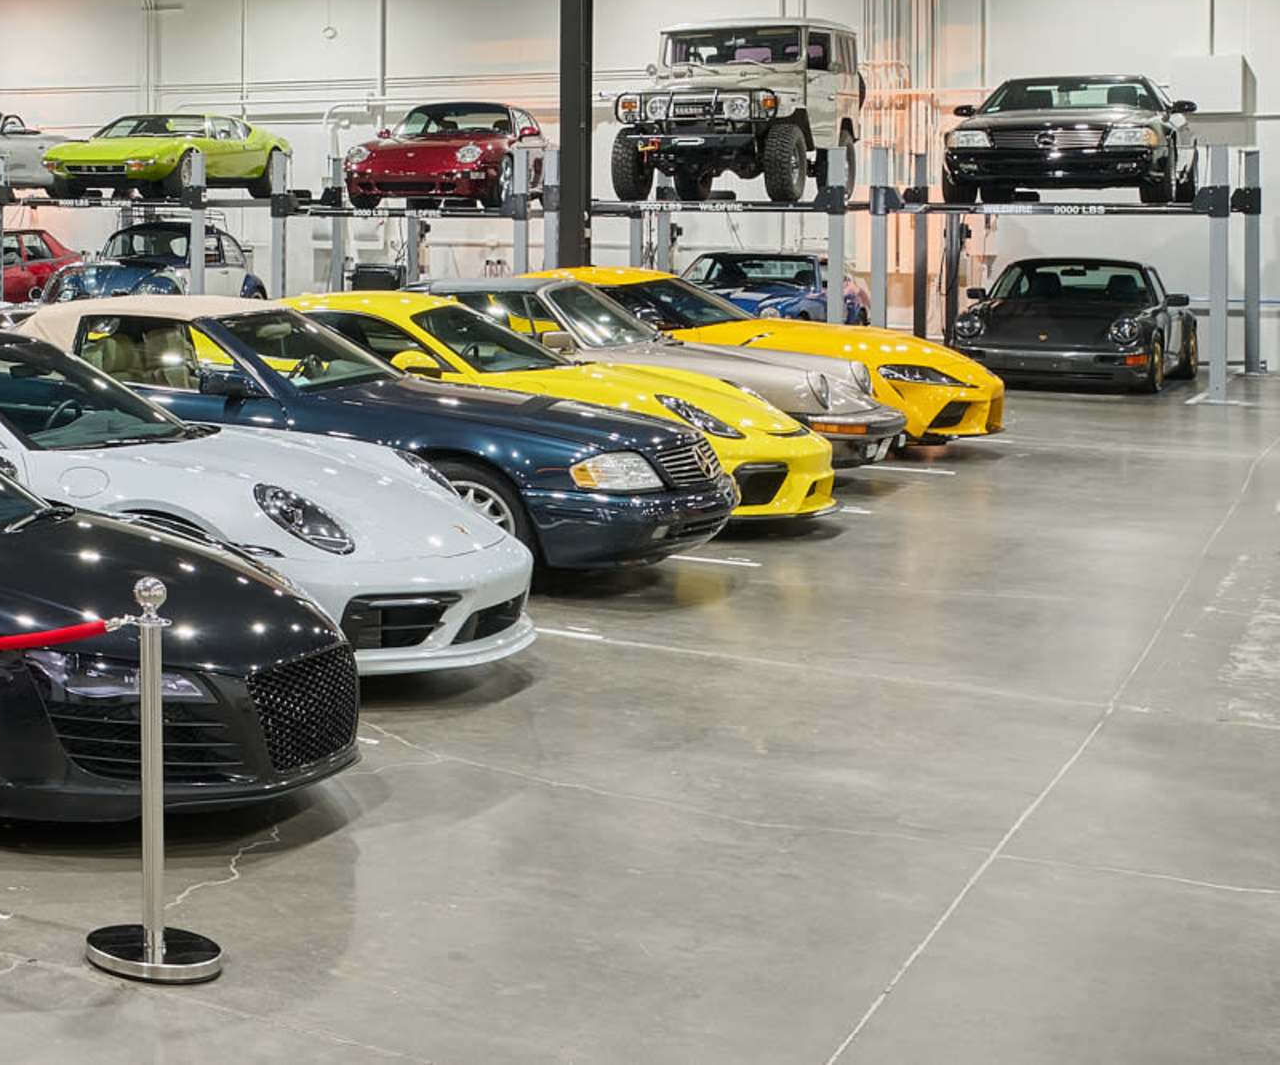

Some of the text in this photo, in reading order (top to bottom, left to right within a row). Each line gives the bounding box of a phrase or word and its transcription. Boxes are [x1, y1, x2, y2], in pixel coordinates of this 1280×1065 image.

[699, 202, 743, 212] WILDFIRE
[1053, 205, 1105, 214] 9000 LBS
